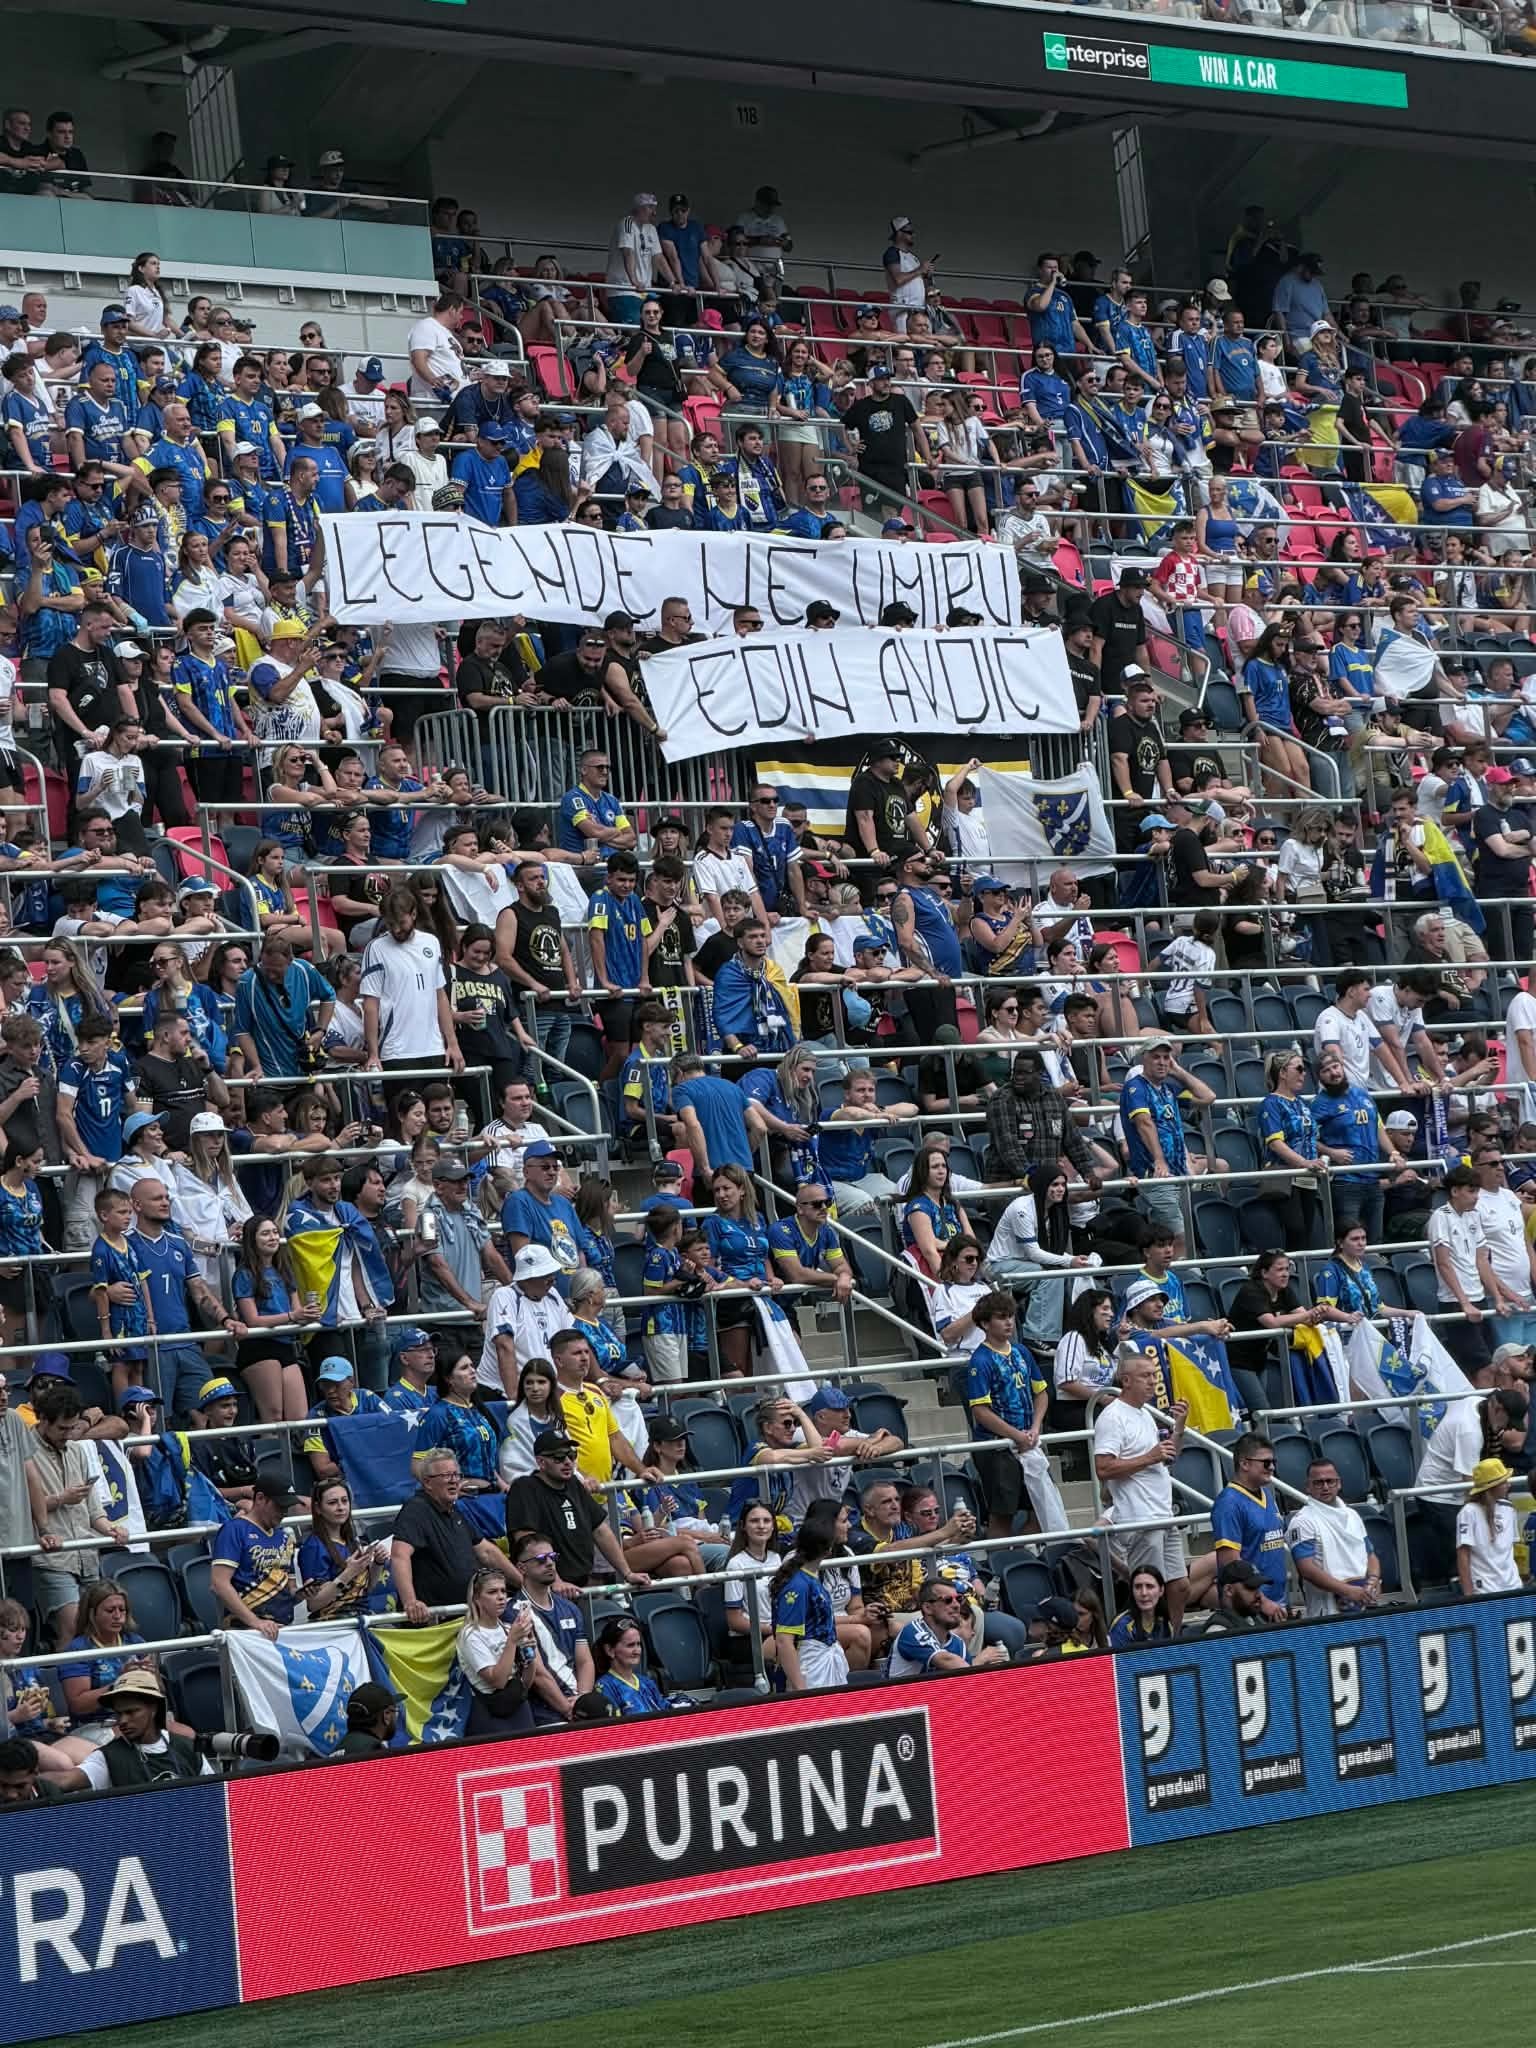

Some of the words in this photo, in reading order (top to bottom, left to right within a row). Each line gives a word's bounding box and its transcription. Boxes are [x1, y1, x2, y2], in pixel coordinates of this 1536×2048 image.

[1050, 42, 1148, 70] enterprise
[1199, 55, 1230, 84] WIN
[1233, 61, 1248, 87] A
[1248, 61, 1278, 91] CAR
[1056, 392, 1063, 405] 5
[333, 521, 657, 619] LEGENDE
[701, 543, 818, 626] NE
[688, 643, 855, 736] EDIN
[623, 924, 637, 941] 19
[415, 973, 425, 991] 11
[1353, 1109, 1369, 1125] 20
[1339, 1743, 1394, 1775] goodwill
[1428, 1729, 1482, 1760] goodwill
[1148, 1773, 1207, 1807] goodwill
[1245, 1758, 1302, 1791] goodwill
